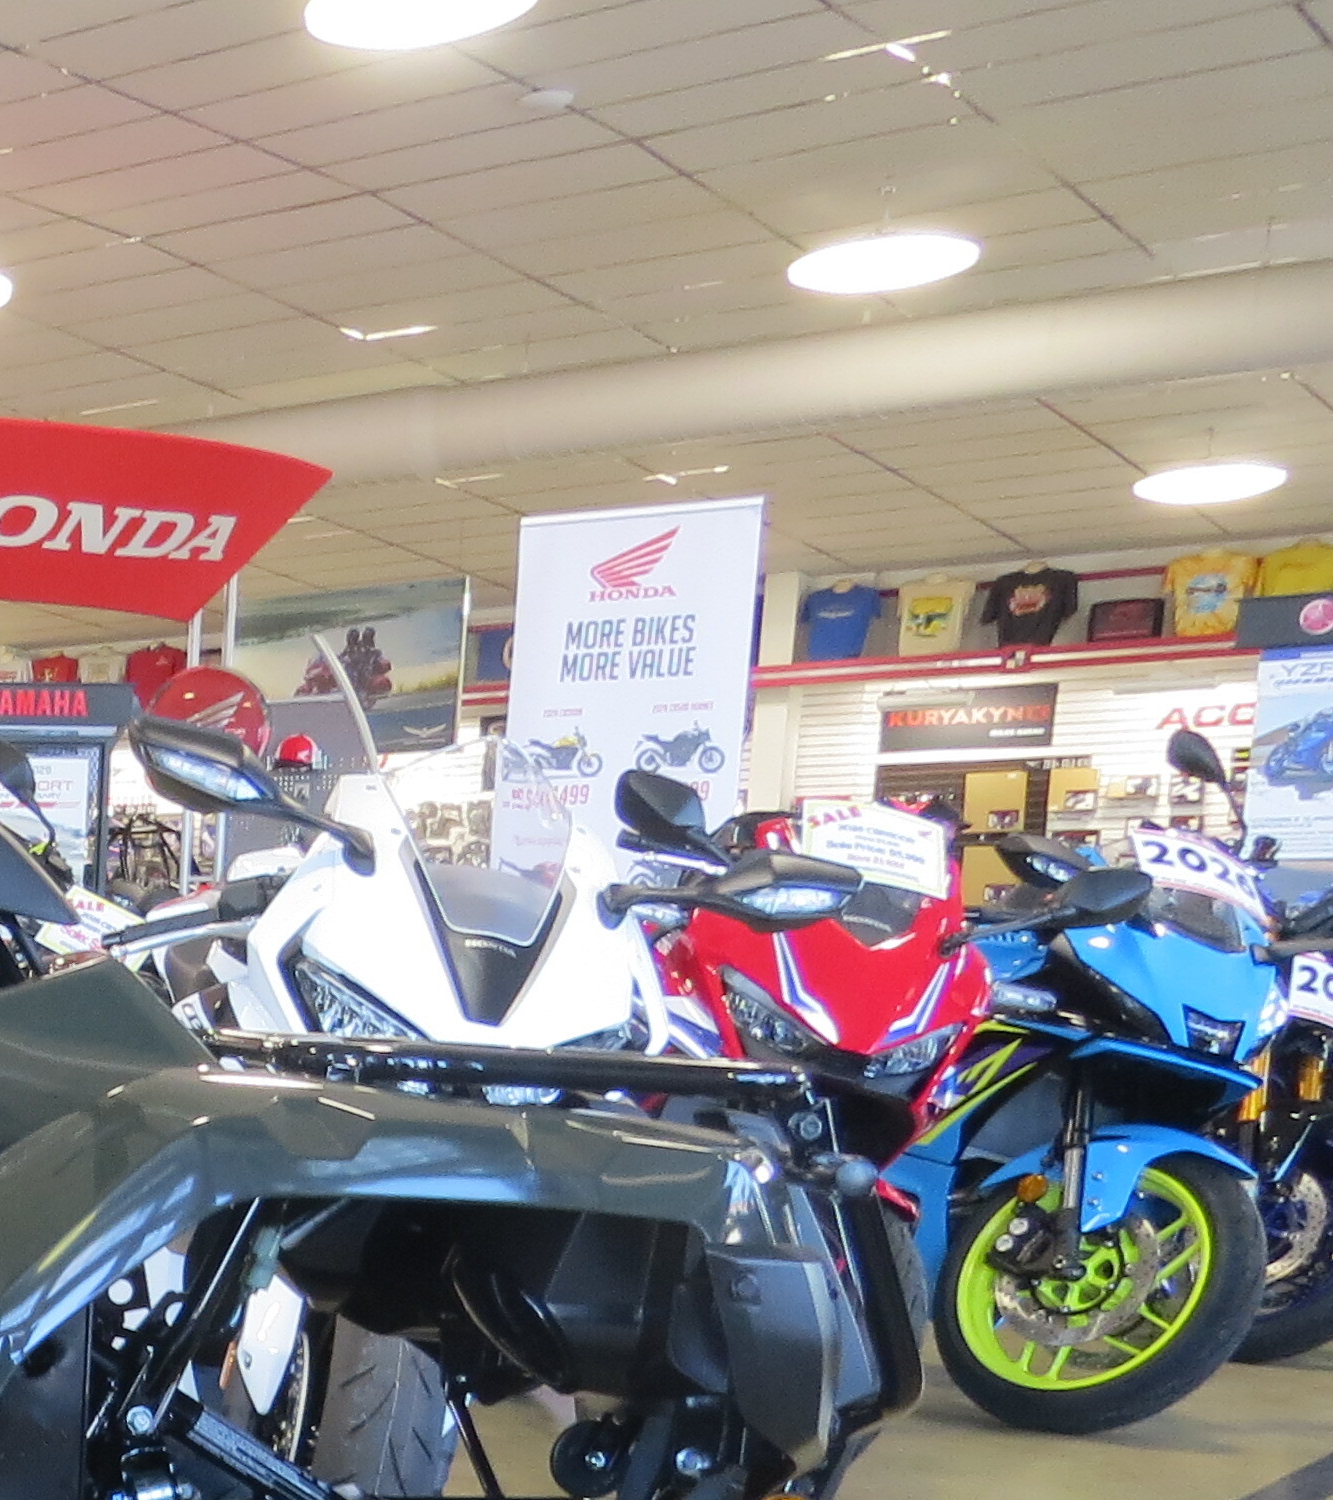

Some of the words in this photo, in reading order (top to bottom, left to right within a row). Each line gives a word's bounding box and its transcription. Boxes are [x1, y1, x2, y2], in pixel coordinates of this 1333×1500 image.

[588, 585, 677, 603] HONDA
[565, 618, 627, 651] MORE
[632, 614, 696, 648] BIKES
[560, 650, 622, 683] MORE
[628, 646, 697, 680] VALUE
[807, 806, 862, 829] SALE
